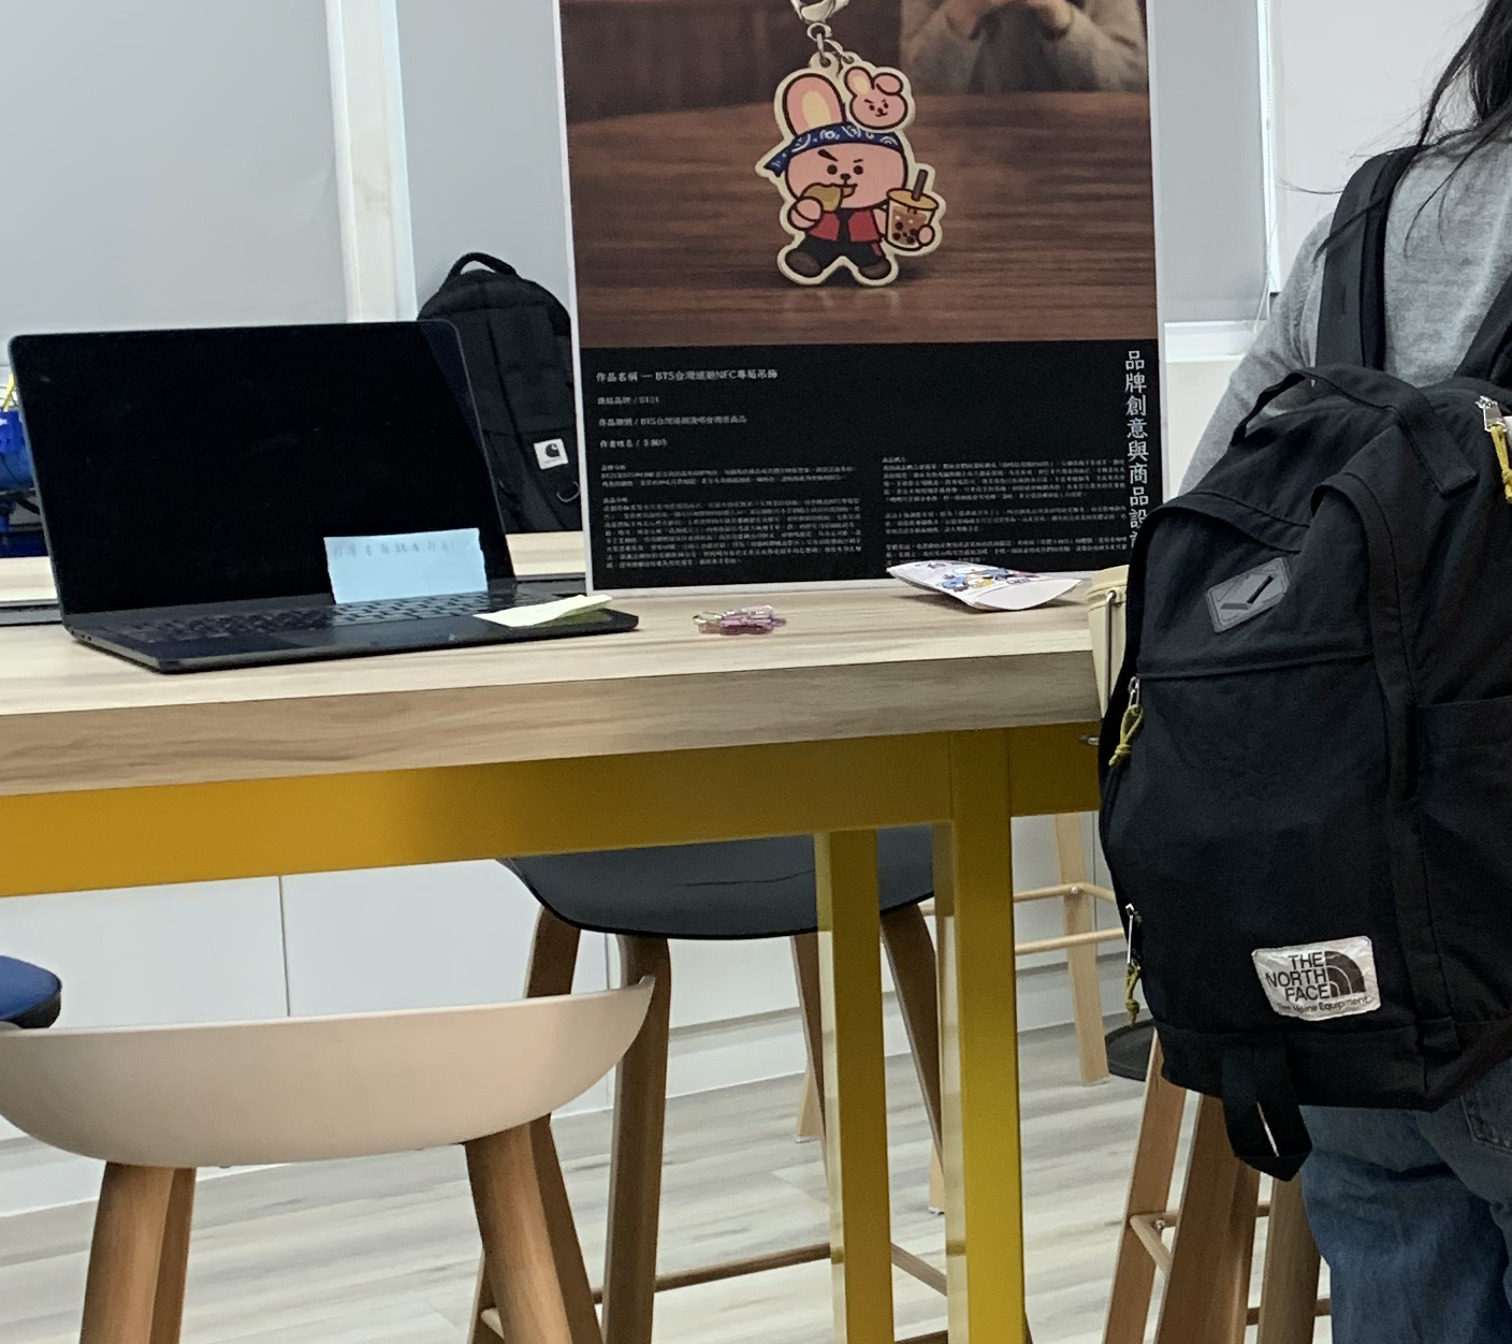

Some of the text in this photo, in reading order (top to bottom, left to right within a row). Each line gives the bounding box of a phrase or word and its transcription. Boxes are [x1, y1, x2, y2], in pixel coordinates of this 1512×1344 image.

[1288, 951, 1325, 970] THE
[1265, 968, 1328, 988] NORTH
[1285, 983, 1330, 1002] FACE
